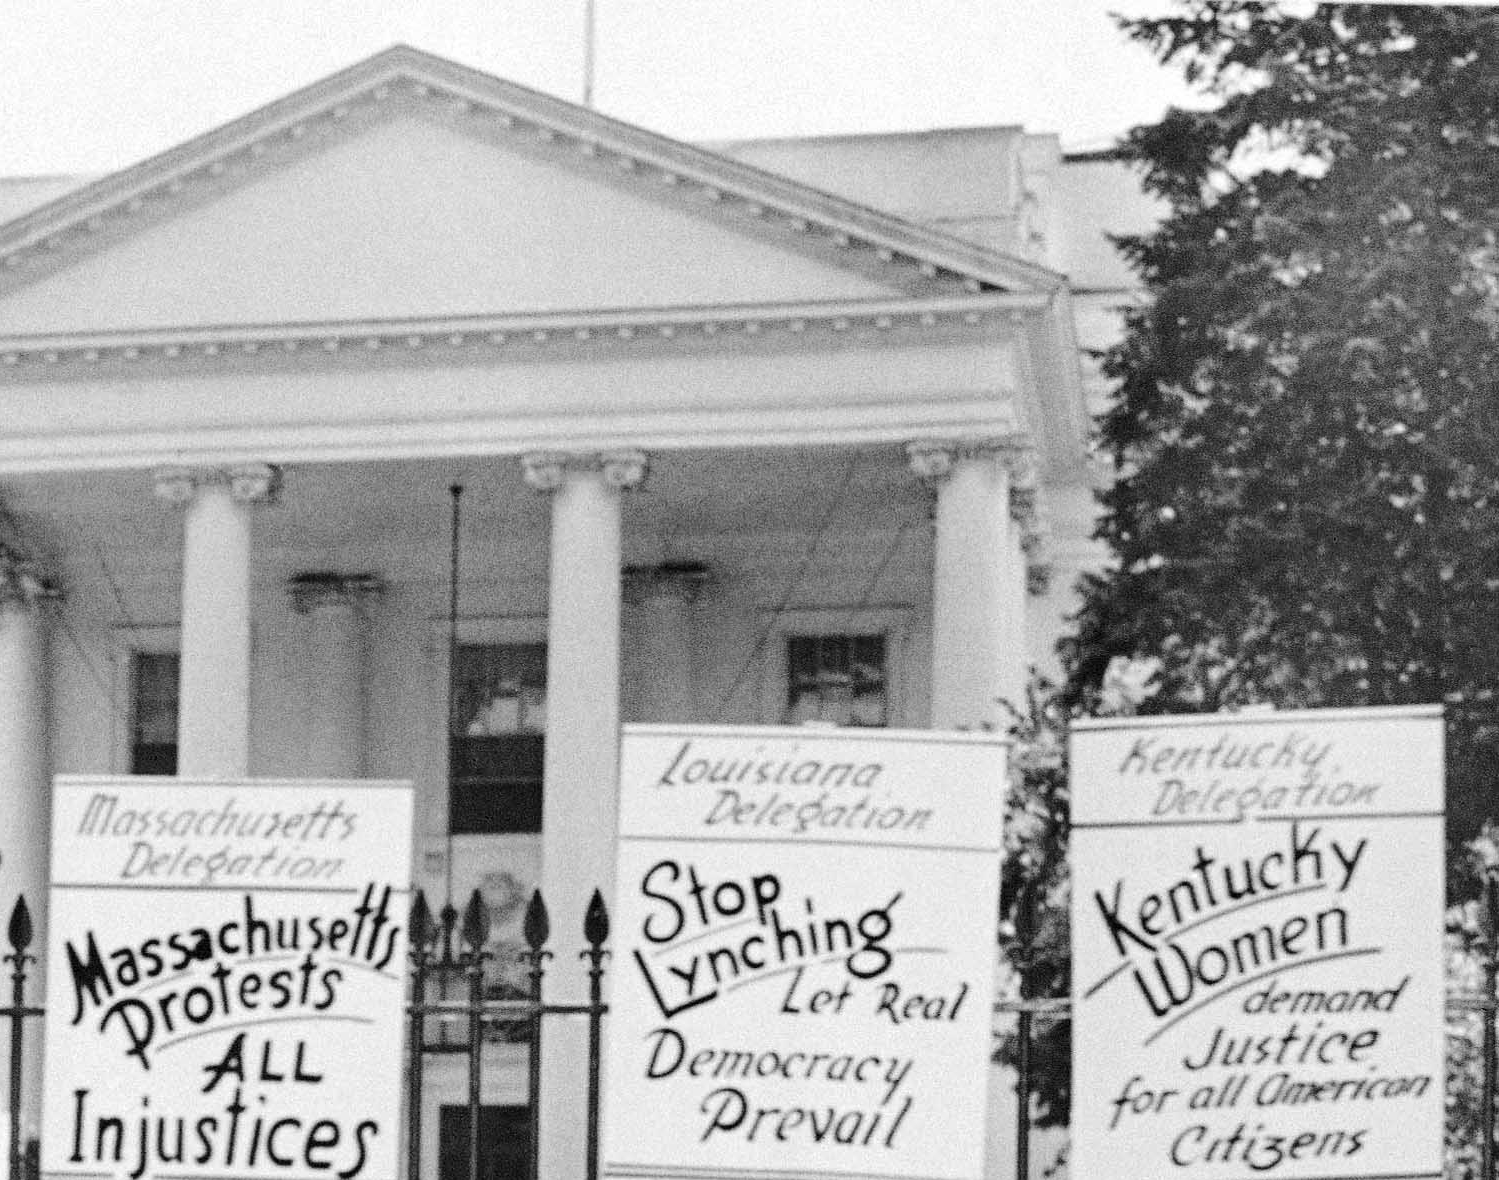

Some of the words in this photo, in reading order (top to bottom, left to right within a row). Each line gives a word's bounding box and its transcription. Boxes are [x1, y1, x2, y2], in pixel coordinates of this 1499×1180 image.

[656, 742, 883, 789] Louisiana
[1153, 770, 1382, 822] Delegation
[77, 793, 358, 840] Massachusetts
[704, 788, 934, 834] Delegation
[119, 841, 346, 882] Delegation
[1094, 819, 1368, 956] Kentucky
[641, 860, 781, 943] Stop
[64, 882, 401, 1026] Massachusetts
[632, 891, 903, 1019] Lynching
[1132, 907, 1348, 1017] Women
[98, 953, 345, 1072] Protests
[780, 966, 853, 1015] Let
[876, 982, 969, 1025] Real
[1242, 975, 1411, 1015] demand
[202, 1032, 324, 1094] ALL
[644, 1028, 914, 1105] Democracy
[1183, 1021, 1381, 1070] Justice
[700, 1087, 913, 1149] Prevail
[1111, 1075, 1179, 1130] for
[1189, 1075, 1249, 1112] all
[1255, 1066, 1431, 1110] American
[68, 1087, 379, 1180] Injustices
[1170, 1123, 1368, 1171] Citizens
